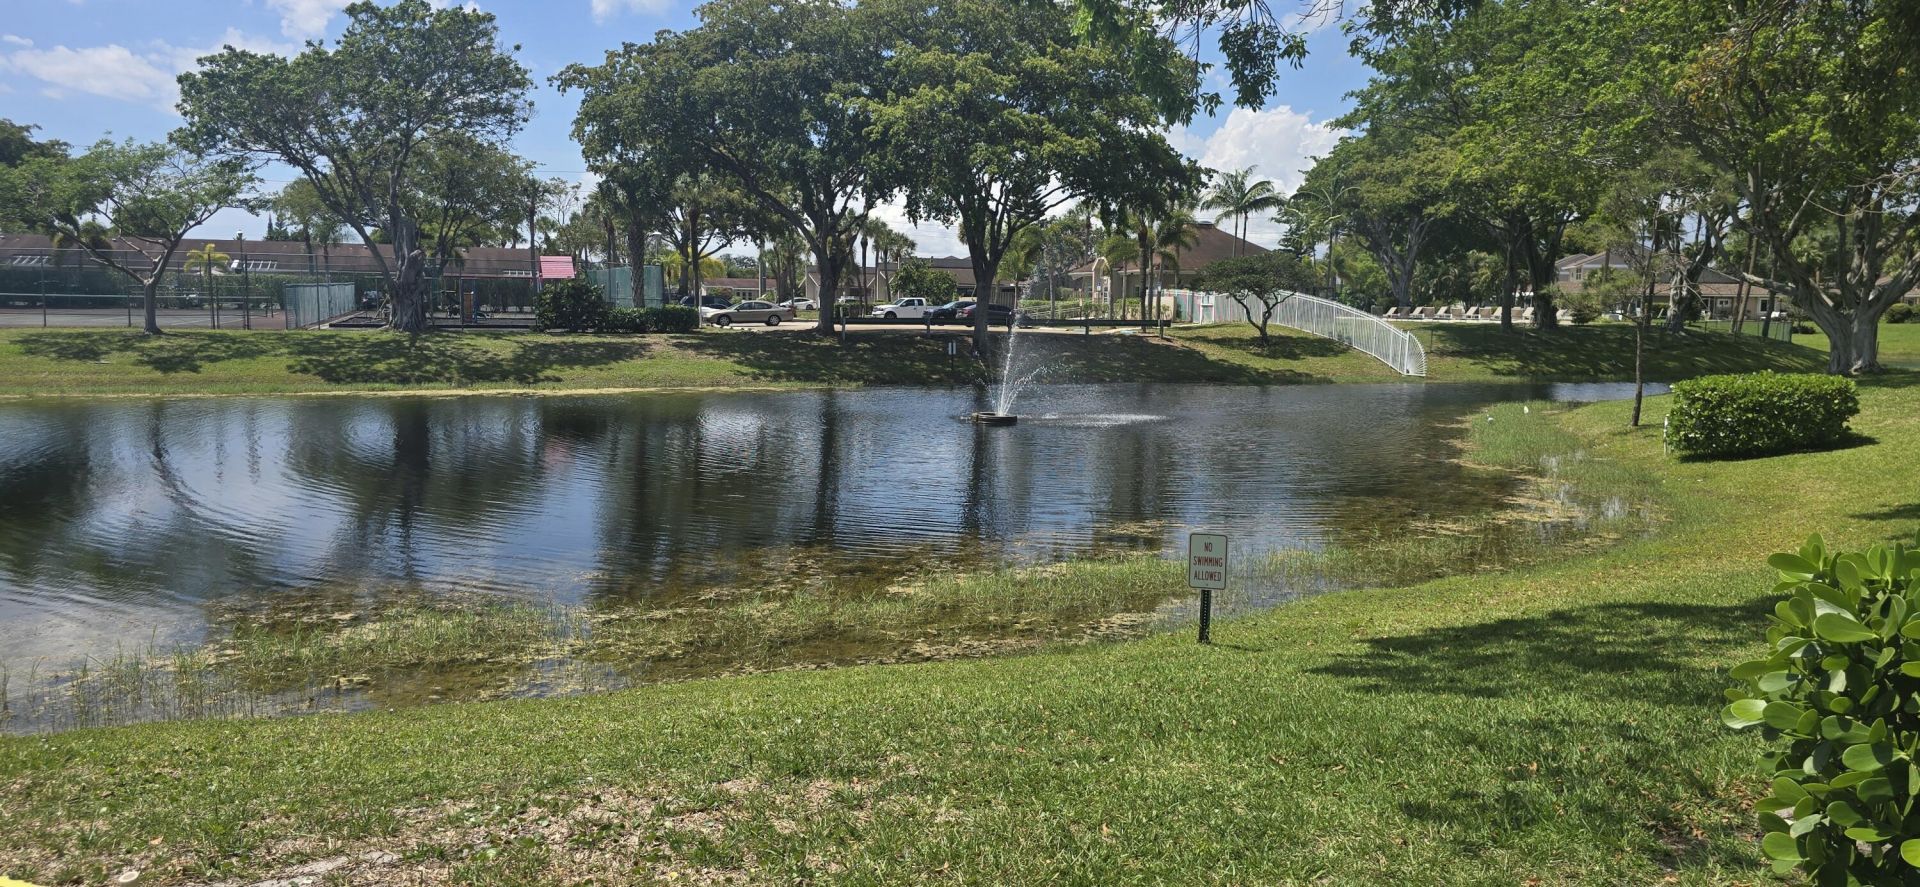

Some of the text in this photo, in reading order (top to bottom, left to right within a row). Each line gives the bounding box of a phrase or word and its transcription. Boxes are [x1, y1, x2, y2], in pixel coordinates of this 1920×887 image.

[1204, 541, 1213, 552] NO
[1193, 556, 1223, 567] SWIMMING
[1193, 570, 1222, 581] ALLOWED
